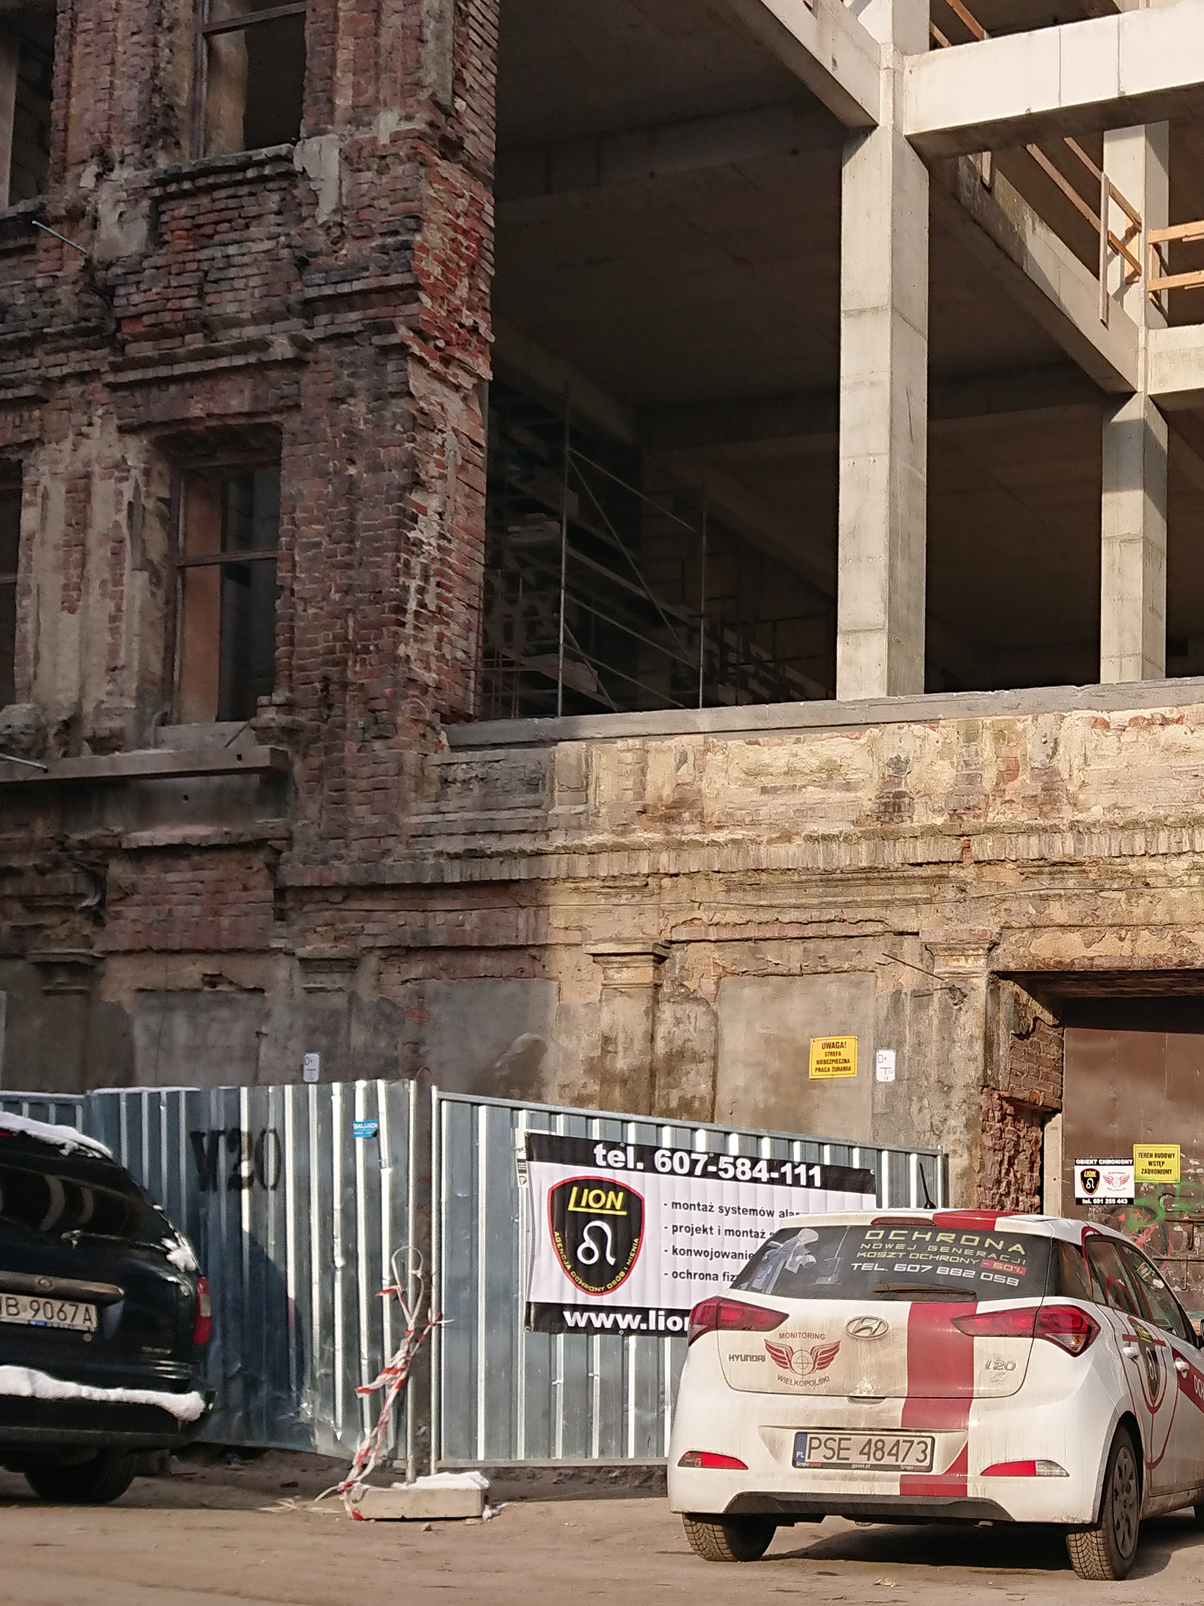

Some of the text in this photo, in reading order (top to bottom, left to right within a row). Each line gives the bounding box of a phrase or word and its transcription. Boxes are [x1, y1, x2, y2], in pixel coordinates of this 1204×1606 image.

[821, 1041, 847, 1050] UWAGA!
[594, 1143, 822, 1187] tel. 607-584-111
[1148, 1160, 1165, 1168] WSTĘP
[567, 1186, 628, 1216] LION
[671, 1200, 715, 1214] montaż
[717, 1202, 775, 1221] systemów
[671, 1223, 713, 1241] projekt
[717, 1225, 721, 1236] i
[724, 1226, 766, 1240] montaż
[864, 1229, 1026, 1256] OCHRONA
[553, 1231, 572, 1271] AGENCJA
[570, 1270, 606, 1292] OCHRONY
[626, 1238, 640, 1266] MIENIA
[671, 1246, 755, 1262] konwojowanie
[856, 1251, 907, 1259] KOSZT
[908, 1252, 980, 1266] OCHRONY
[859, 1242, 1027, 1266] NOWEJ GENERACJI
[671, 1269, 740, 1283] ochrona fiz
[851, 1262, 1020, 1287] TEL. 607 882 058
[0, 1294, 93, 1326] B 9067A
[778, 1332, 826, 1341] MONITORING
[728, 1353, 766, 1363] HYUNDAI
[777, 1374, 831, 1388] WIELKOPOLSKI
[795, 1451, 805, 1459] PL
[807, 1436, 929, 1463] PSE 48473
